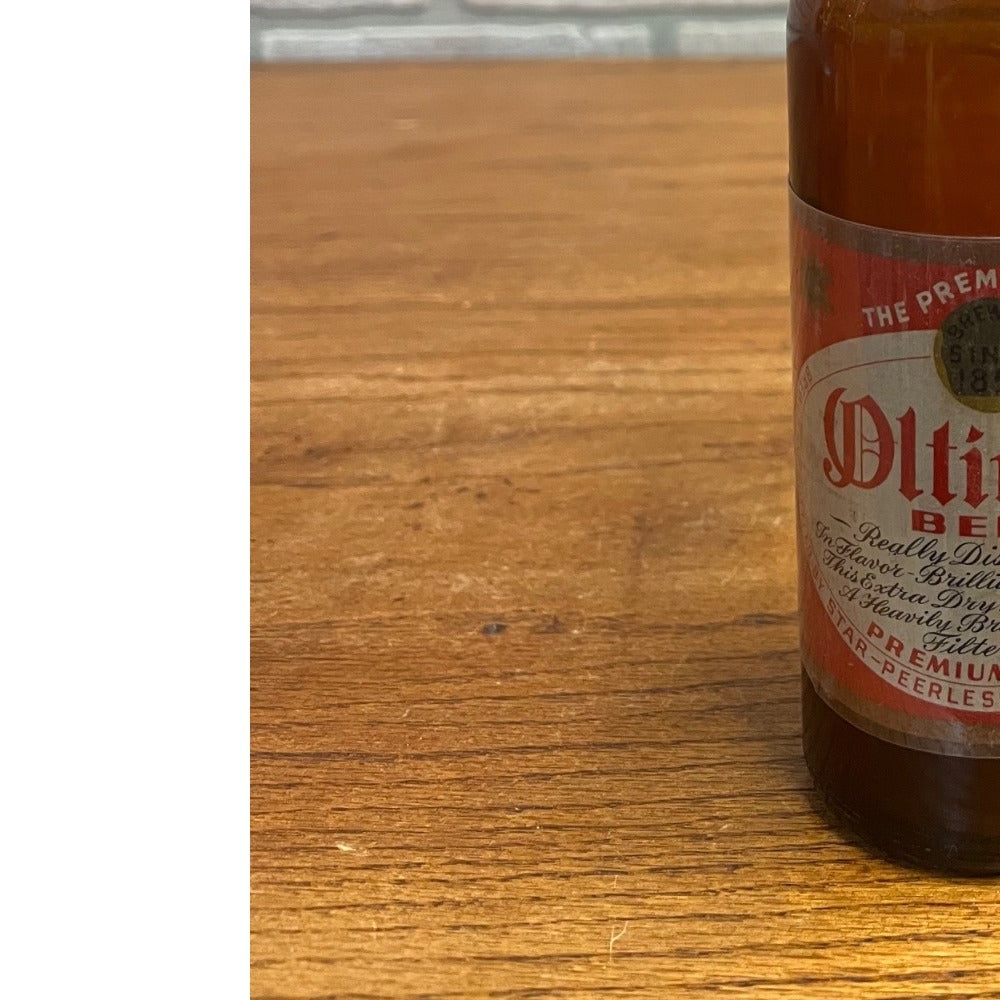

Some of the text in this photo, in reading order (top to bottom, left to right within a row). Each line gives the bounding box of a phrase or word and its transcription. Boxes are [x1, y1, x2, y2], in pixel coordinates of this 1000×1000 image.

[862, 301, 910, 328] THE
[815, 521, 835, 548] In
[853, 521, 950, 565] Really
[822, 549, 858, 583] This
[860, 572, 930, 604] Extra
[931, 588, 1000, 614] Dry
[838, 584, 860, 601] A
[859, 593, 953, 633] Heavily
